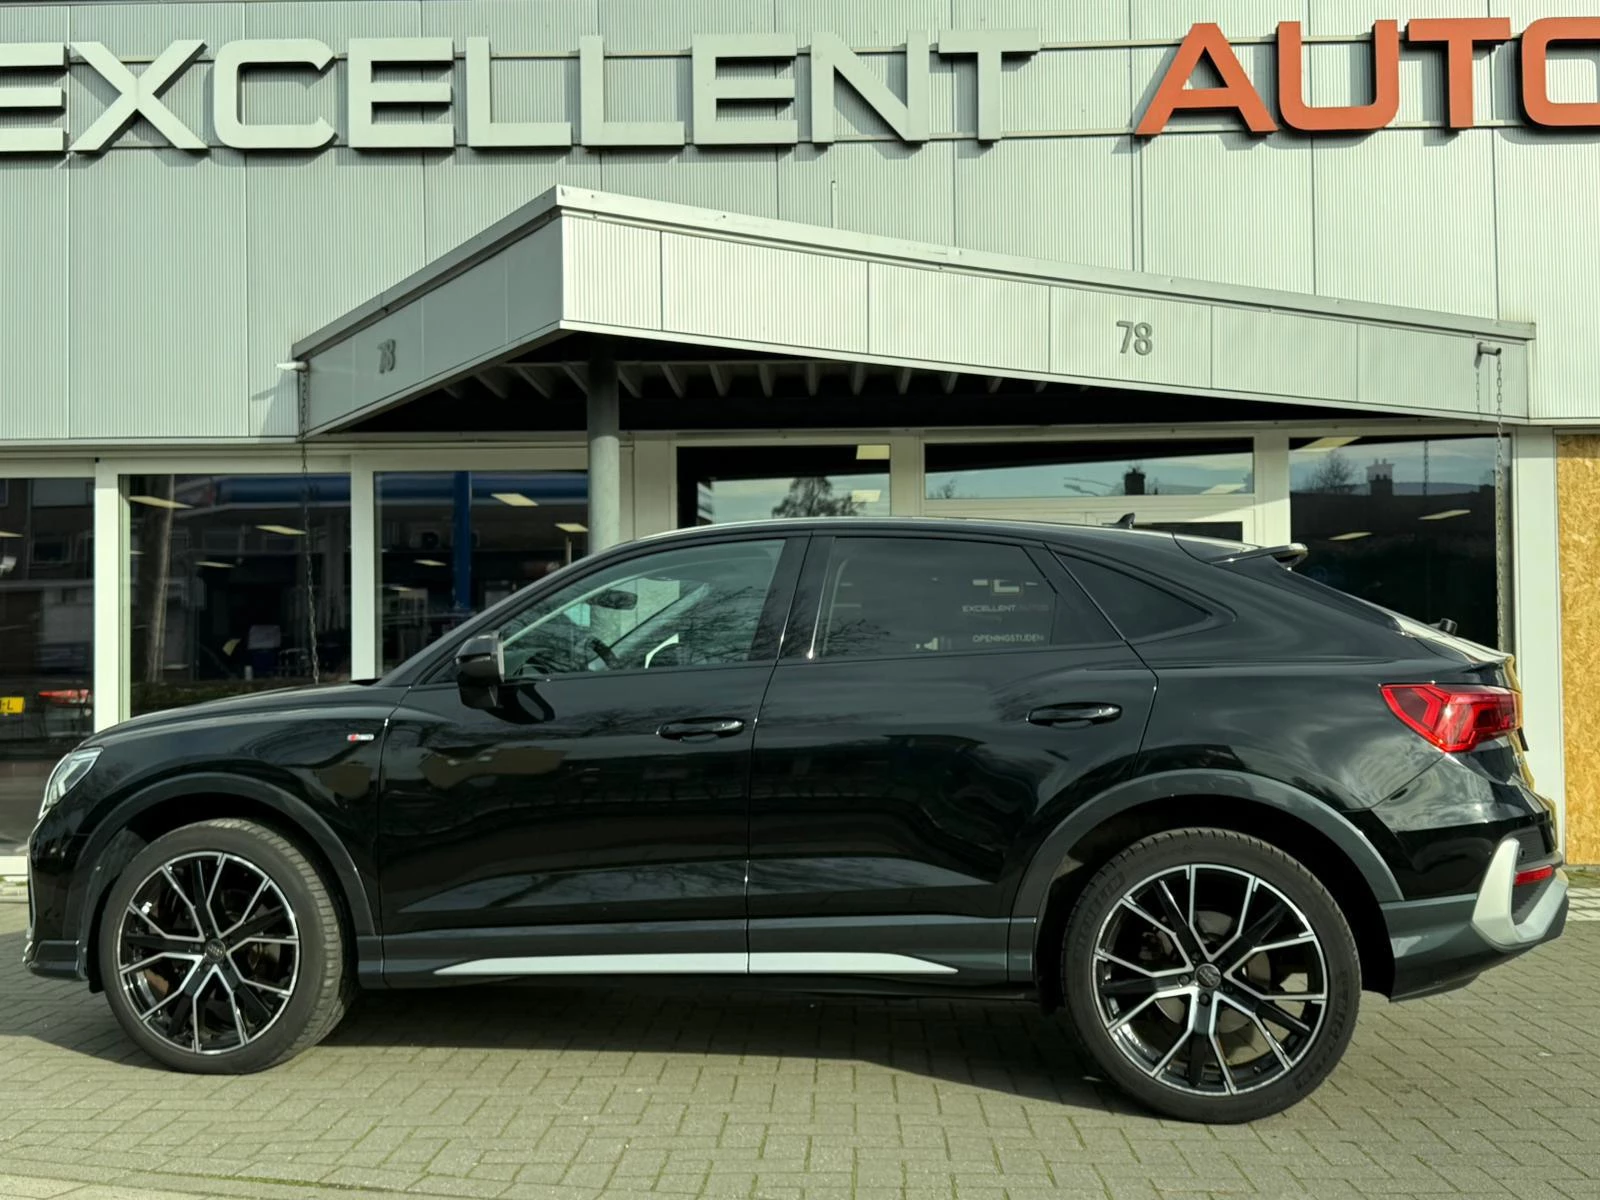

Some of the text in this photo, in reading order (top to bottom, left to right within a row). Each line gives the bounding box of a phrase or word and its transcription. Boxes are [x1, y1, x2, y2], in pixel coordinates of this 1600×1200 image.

[0, 17, 1600, 151] EXCELLENT AUTO
[1116, 320, 1152, 355] 78
[961, 604, 1016, 613] EXCELLENT
